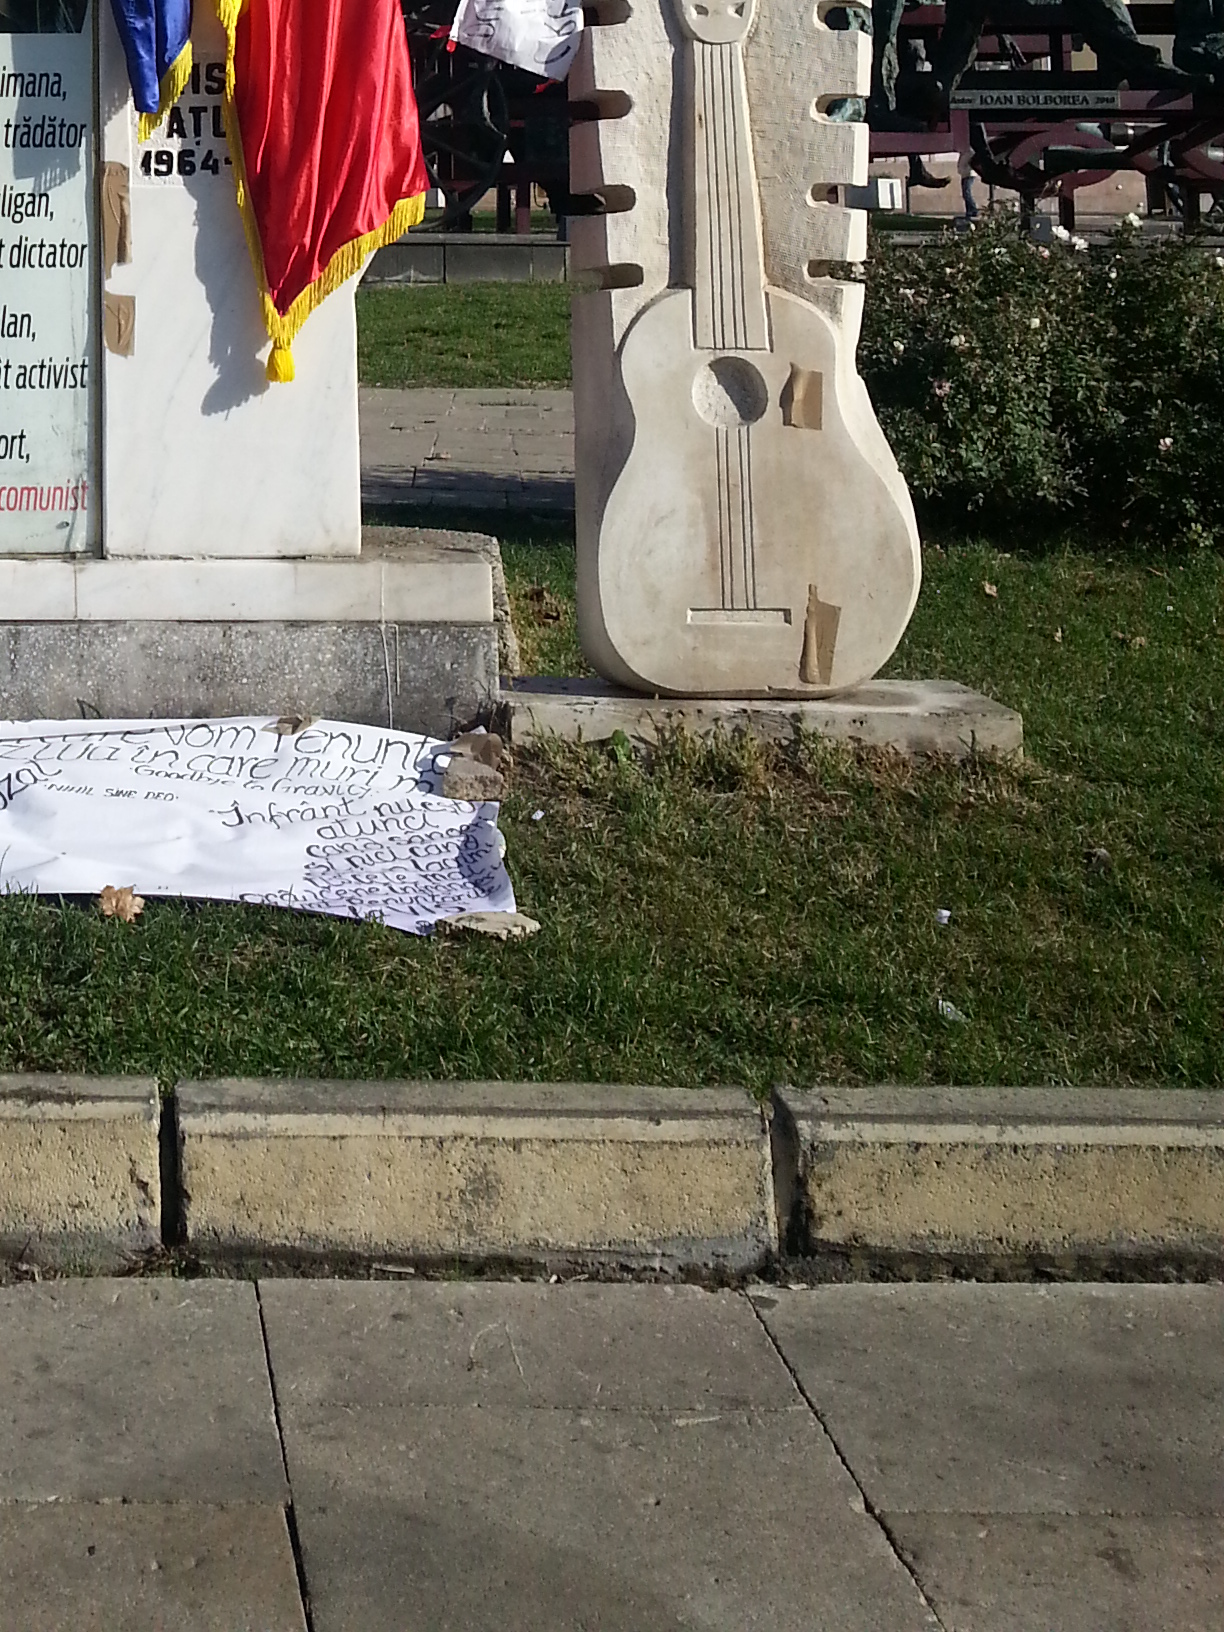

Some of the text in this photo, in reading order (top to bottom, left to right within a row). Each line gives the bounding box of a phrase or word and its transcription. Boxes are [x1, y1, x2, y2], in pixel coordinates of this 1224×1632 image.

[979, 94, 1014, 106] IOAN
[1017, 94, 1090, 106] BOLBOREA
[4, 115, 87, 149] trădător
[9, 235, 87, 269] dictator
[15, 357, 88, 389] activist
